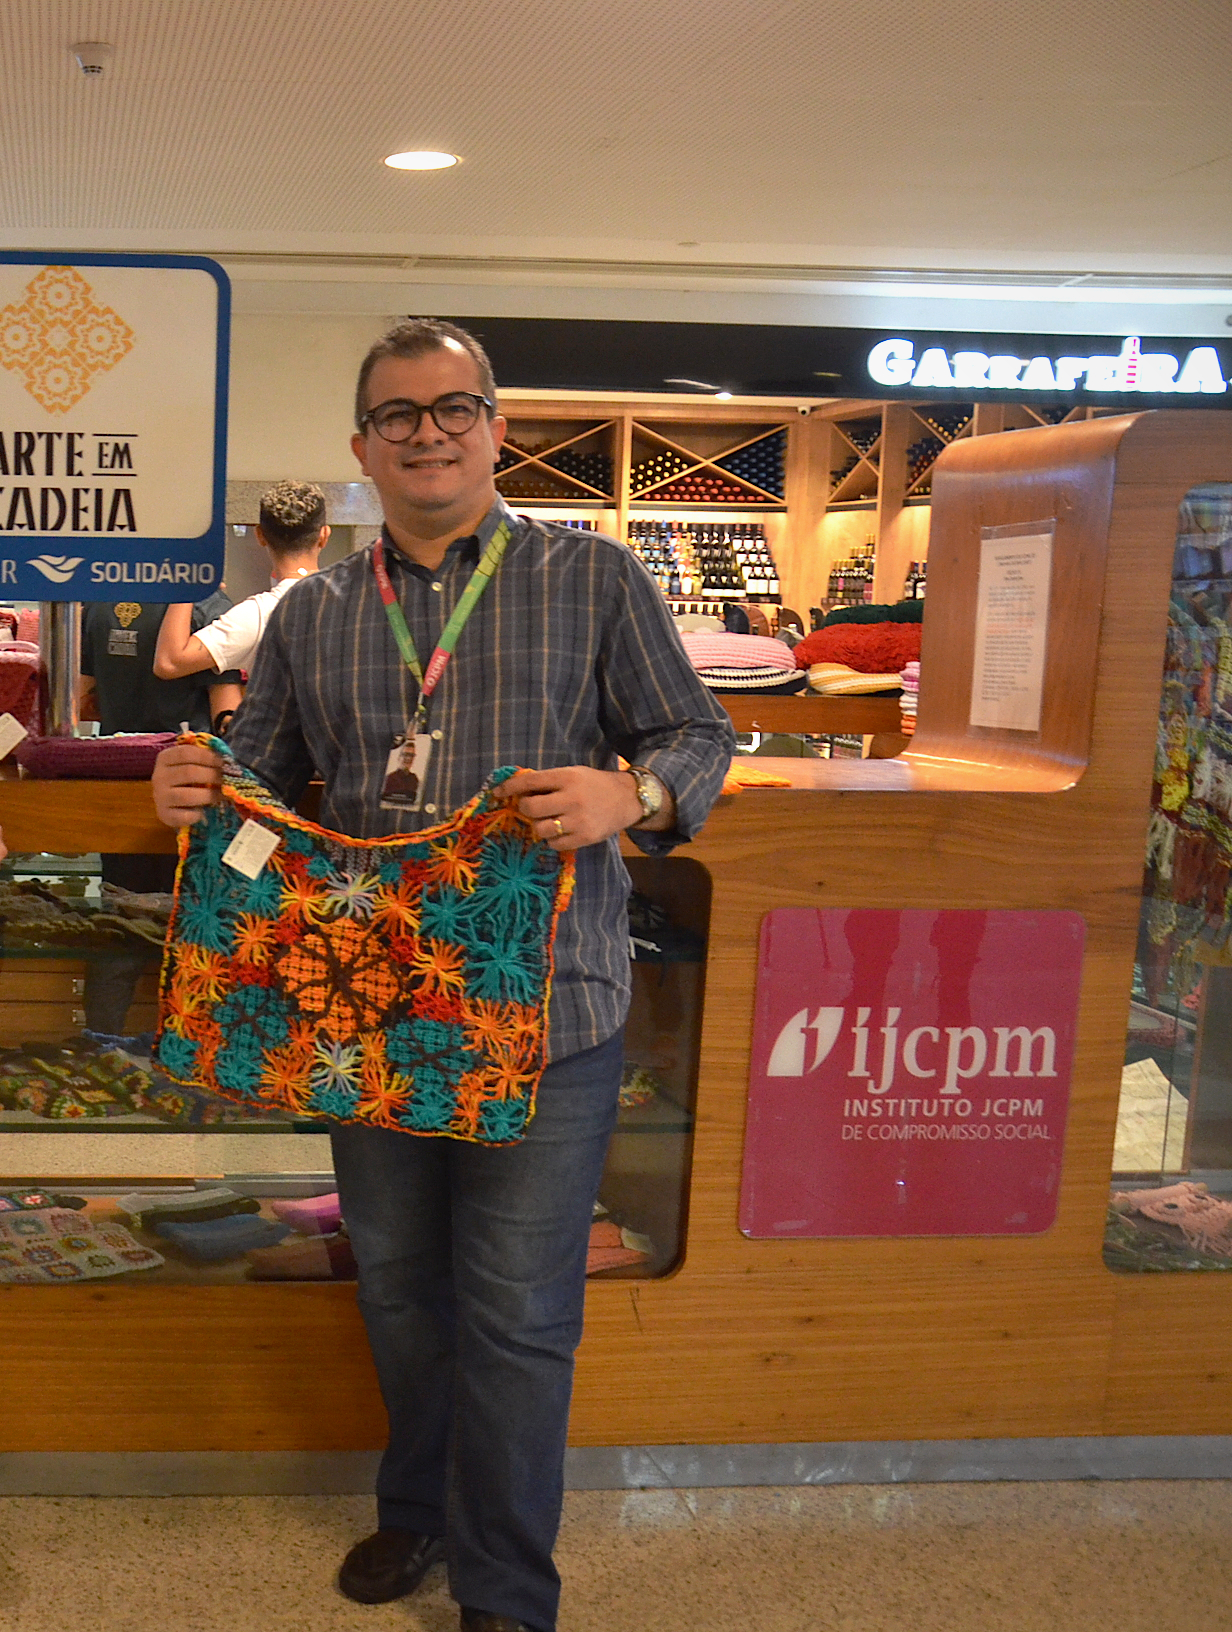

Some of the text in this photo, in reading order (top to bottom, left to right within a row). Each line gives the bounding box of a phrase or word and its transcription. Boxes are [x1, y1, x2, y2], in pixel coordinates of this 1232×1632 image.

[867, 335, 1228, 394] GARRAFEIRA
[98, 442, 133, 469] EM
[90, 557, 216, 585] SOLIDÁRIO
[847, 1006, 1058, 1095] ijcpm
[843, 1099, 1044, 1118] INSTITUTO JCPM
[841, 1124, 1052, 1141] DE COMPROMISSO SOCIAL
